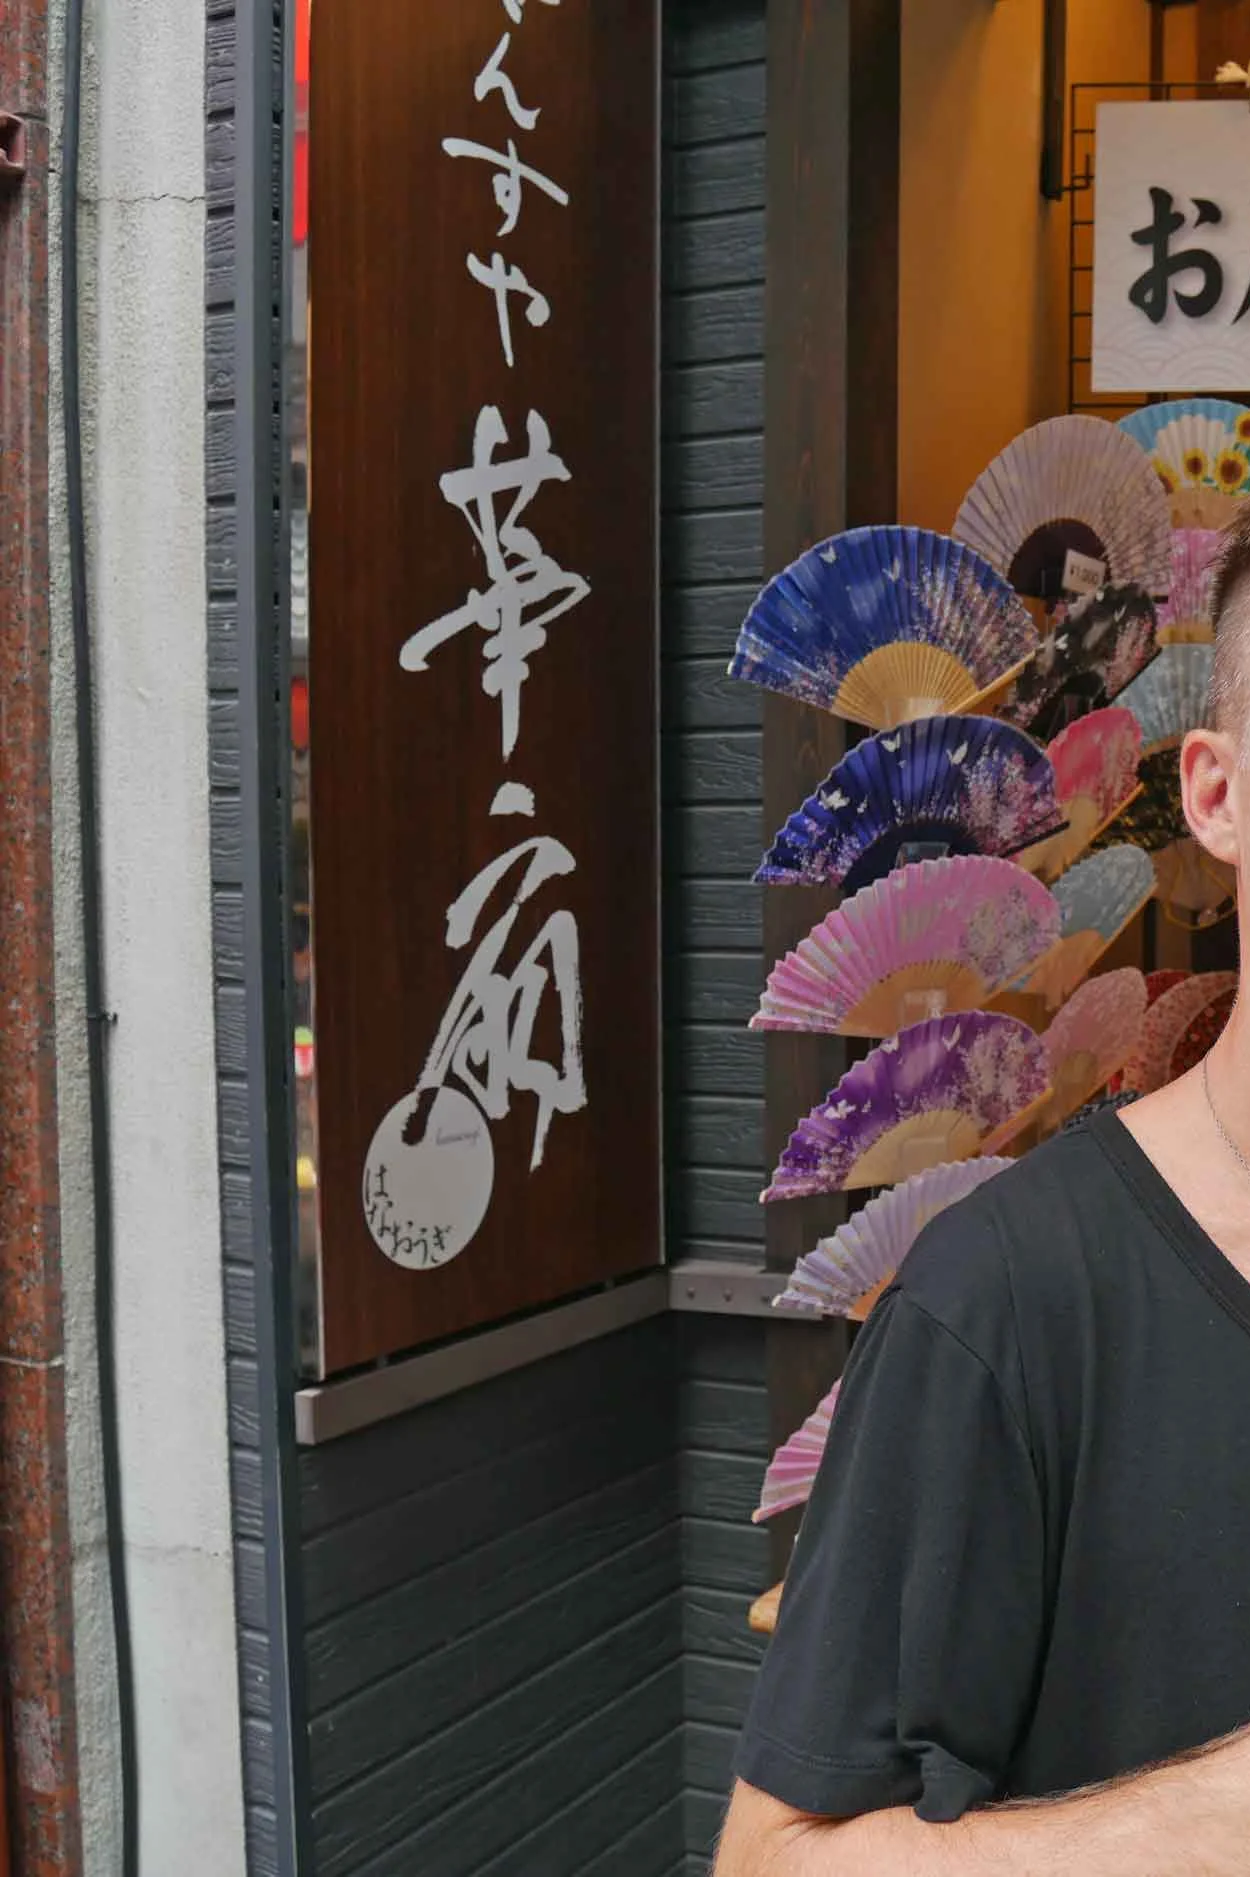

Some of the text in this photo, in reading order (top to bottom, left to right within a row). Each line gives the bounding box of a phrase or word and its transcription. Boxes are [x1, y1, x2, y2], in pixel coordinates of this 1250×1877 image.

[441, 0, 569, 368] んすや
[364, 1164, 452, 1266] はなおうぎ
